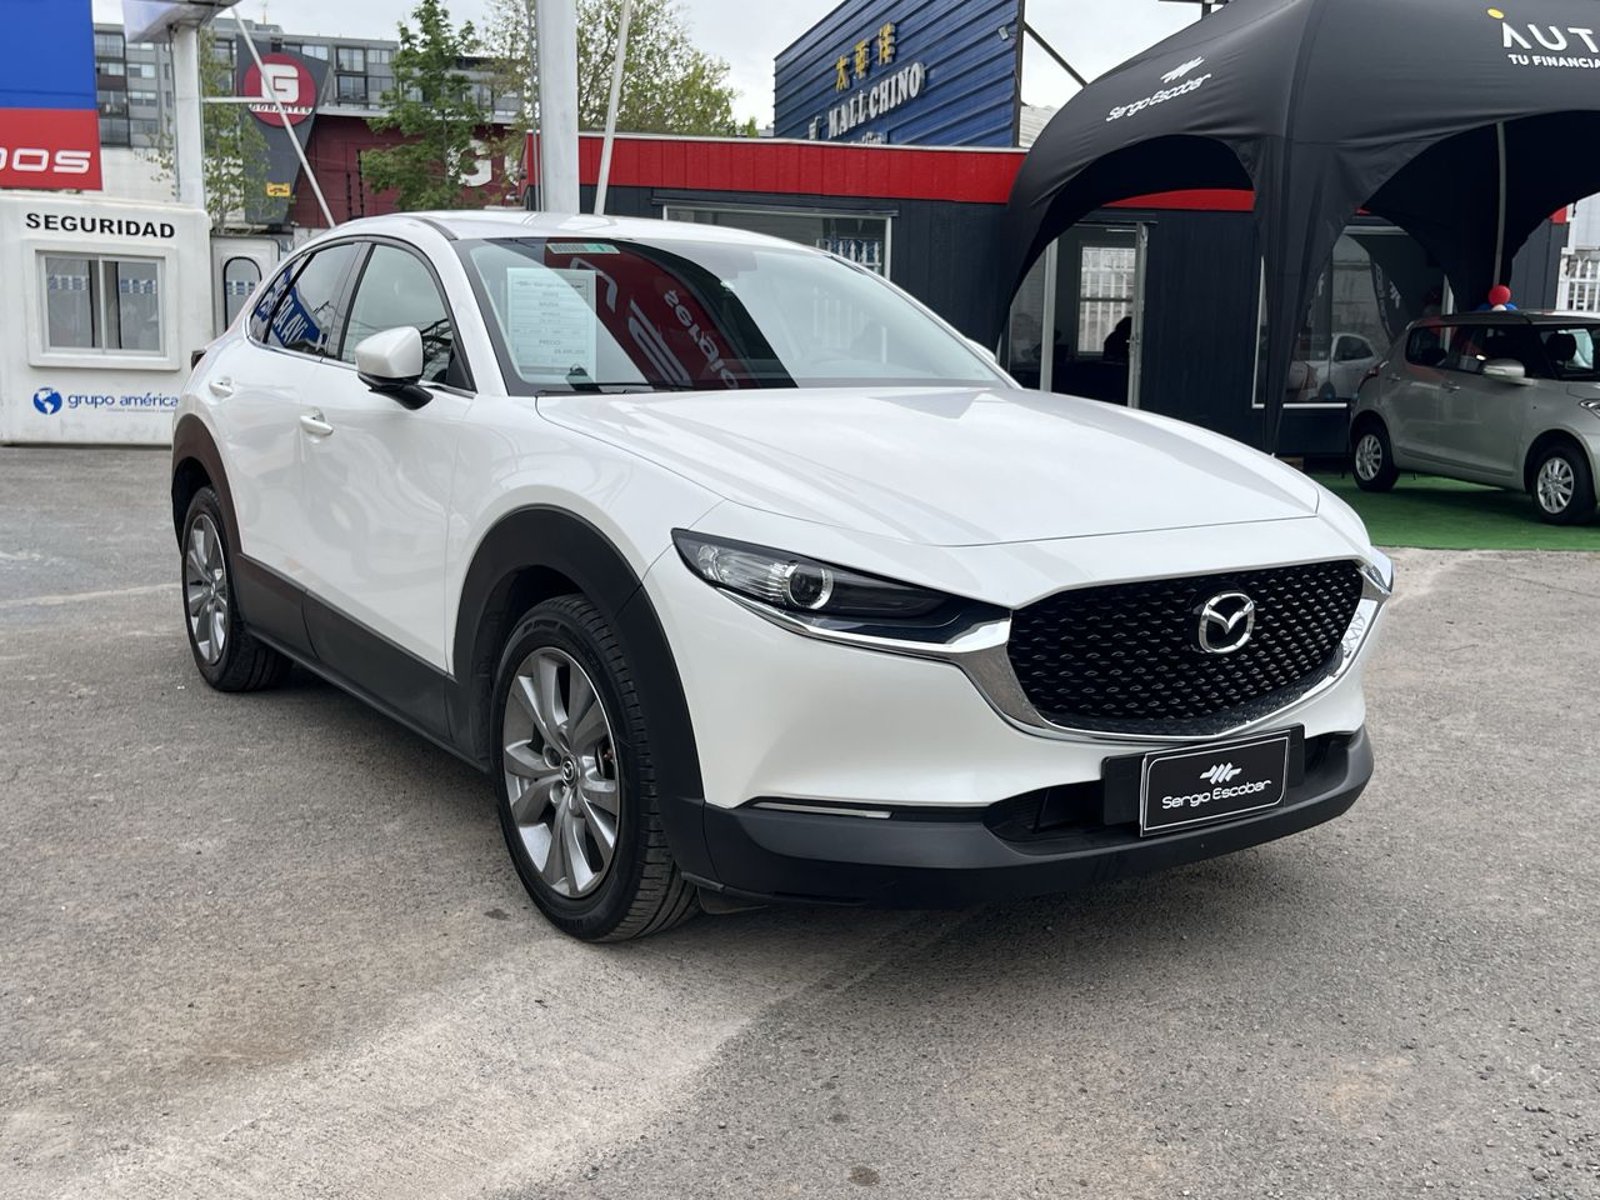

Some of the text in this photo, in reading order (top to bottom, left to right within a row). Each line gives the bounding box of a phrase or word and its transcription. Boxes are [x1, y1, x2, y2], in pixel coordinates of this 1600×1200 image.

[1508, 54, 1529, 65] TU
[828, 62, 924, 138] MALL CHINO
[1149, 73, 1212, 106] Escobar
[0, 147, 91, 174] OS
[26, 213, 175, 238] SEGURIDAD
[68, 392, 179, 408] grupo américa
[1212, 780, 1272, 800] Escobar
